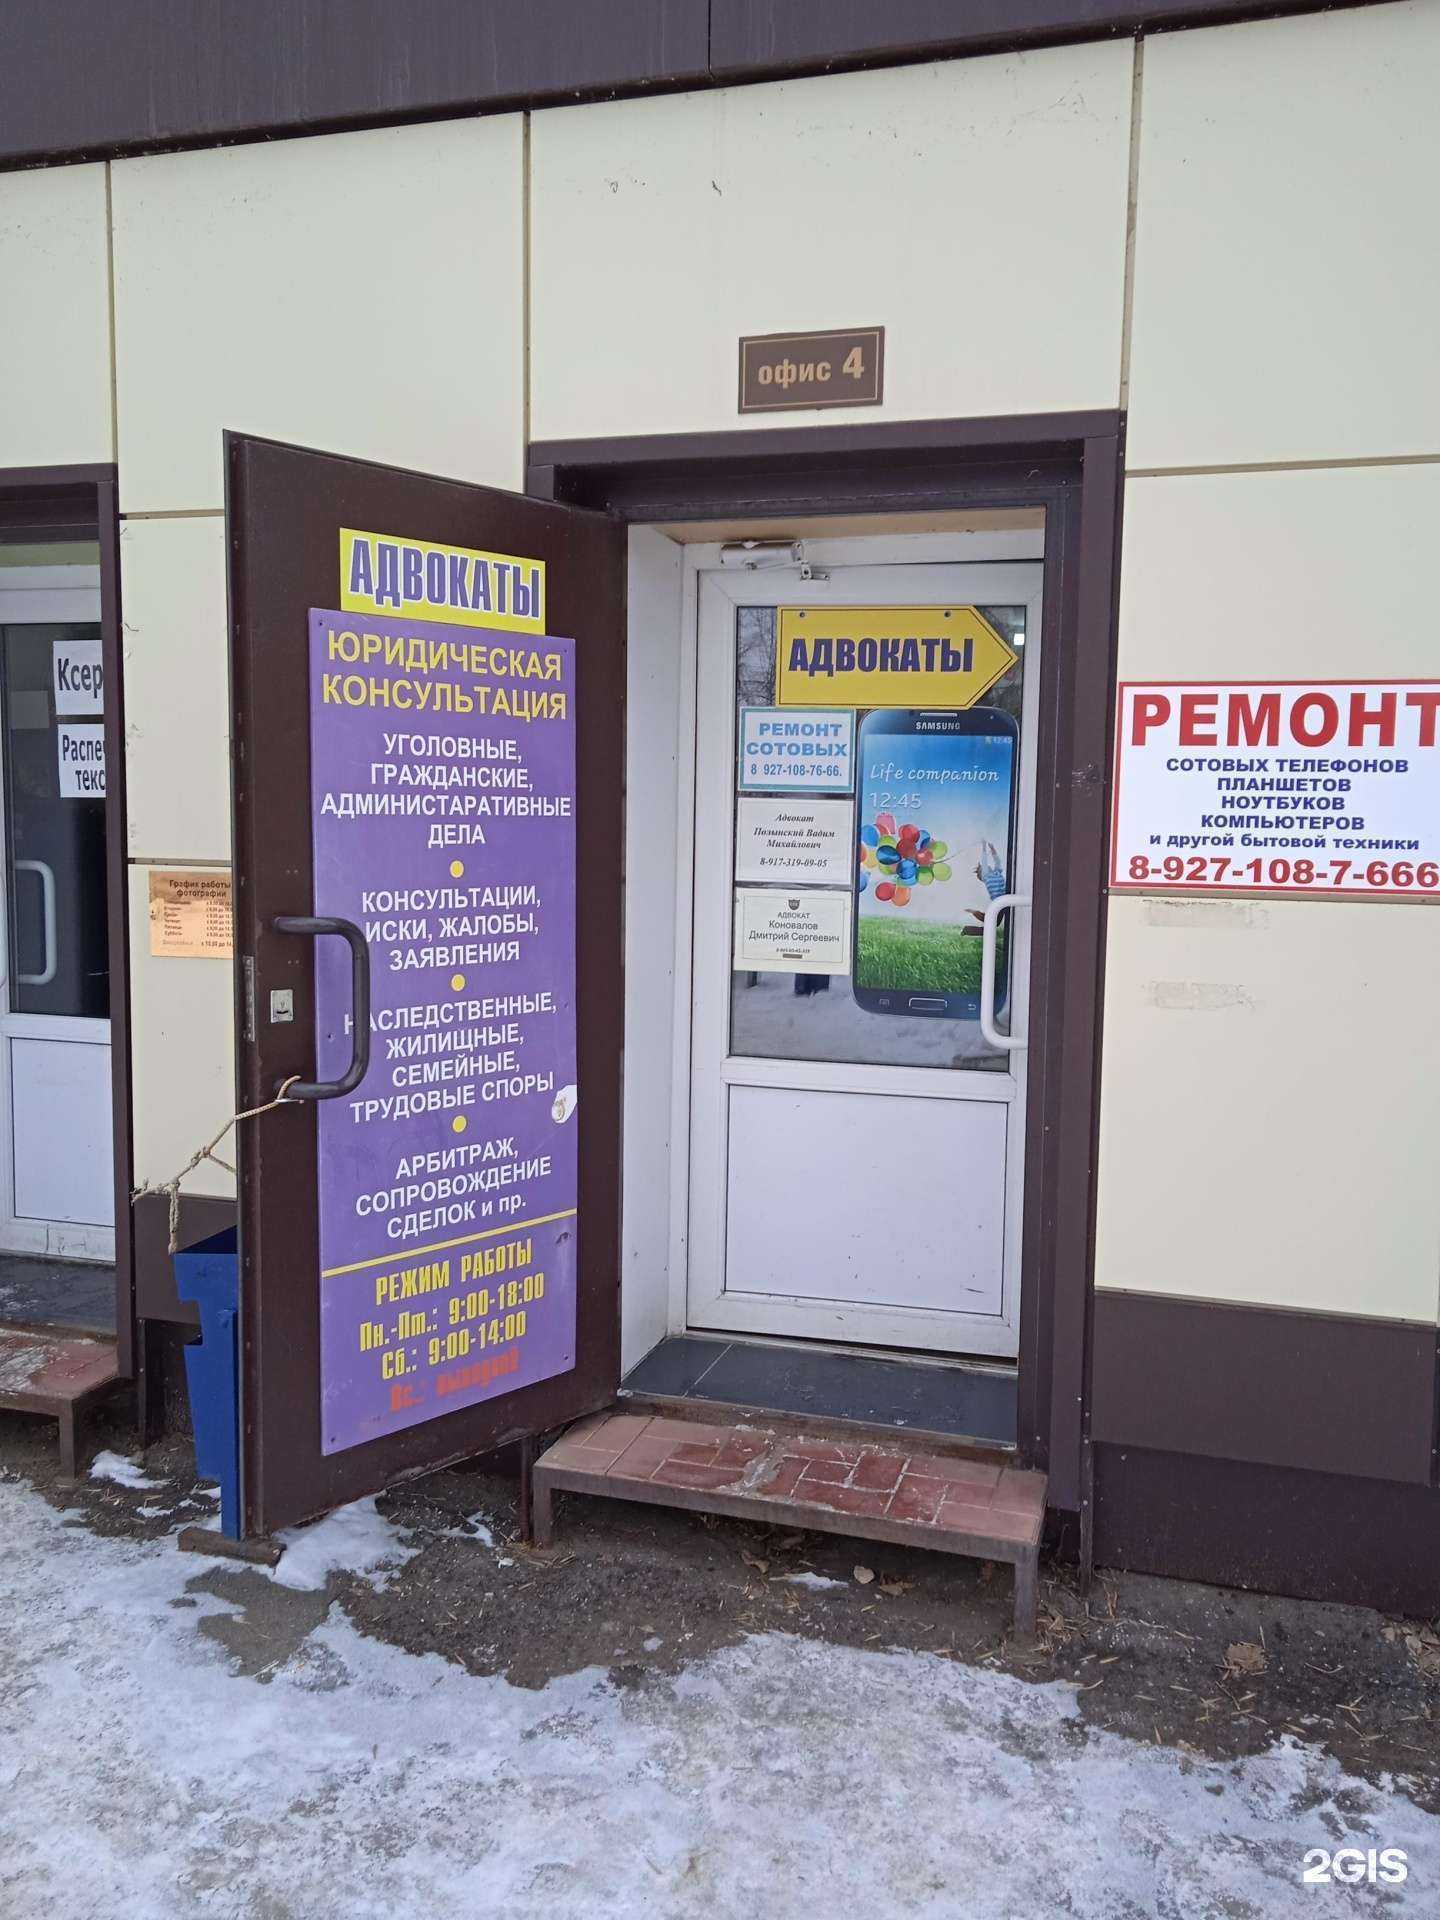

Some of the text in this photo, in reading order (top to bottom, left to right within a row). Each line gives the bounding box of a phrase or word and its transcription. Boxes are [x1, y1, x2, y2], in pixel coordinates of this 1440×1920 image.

[758, 346, 865, 389] офис 4
[349, 538, 541, 619] АДВОКАТЫ
[328, 630, 561, 681] ЮРИДИЧЕСКАЯ
[788, 637, 973, 677] АДВОКАТЫ
[322, 673, 567, 722] КОНСУЛЬТАЦИЯ
[759, 723, 842, 737] РЕМОНТ
[915, 721, 961, 730] SAMSUNG
[1131, 692, 1440, 748] РЕМОНТ
[62, 734, 106, 761] Распе
[383, 733, 522, 764] УГОЛОВНЫЕ,
[746, 742, 848, 757] СОТОВЫХ
[370, 763, 533, 791] ГРАЖДАНСКИЕ,
[750, 763, 842, 777] 8 927-108-76-66.
[870, 762, 1000, 784] Life companion
[1166, 758, 1409, 773] СОТОВЫХ ТЕЛЕФОНОВ
[1217, 777, 1352, 792] ПЛАНШЕТОВ
[320, 792, 571, 819] АДМИНИСТАРАТИВНЫЕ
[869, 792, 922, 809] 12:45
[1221, 796, 1345, 811] НОУТБУКОВ
[776, 813, 815, 823] Адвокат
[1201, 815, 1365, 830] КОМПЬЮТЕРОВ
[428, 824, 486, 849] ДЕЛА
[766, 839, 822, 849] Михайлович
[806, 828, 835, 838] Вадим
[1149, 832, 1419, 851] и другой бытовой техники
[1128, 855, 1439, 888] 8-927-108-7-666
[361, 885, 541, 913] КОНСУЛЬТАЦИИ,
[365, 912, 539, 943] ИСКИ, ЖАЛОБЫ,
[768, 920, 819, 930] Коновалов
[777, 911, 811, 919] АДВОКАТ
[748, 930, 840, 943] Дмитрий Сергеевич
[389, 941, 520, 971] ЗАЯВЛЕНИЯ
[386, 1023, 524, 1060] ЖИЛИЩНЫЕ,
[391, 1051, 520, 1087] СЕМЕЙНЫЕ,
[350, 1071, 554, 1124] ТРУДОВЫЕ СПОРЫ
[395, 1137, 519, 1180] АРБИТРАЖ,
[355, 1156, 551, 1216] СОПРОВОЖДЕНИЕ
[387, 1193, 526, 1240] СДЕЛОК и пр.
[375, 1238, 532, 1306] РЕЖИМ РАБОТЫ
[359, 1272, 545, 1352] Пн.-Пт.: 9:00-18:00
[381, 1311, 526, 1381] Сб.: 9:00-14:00
